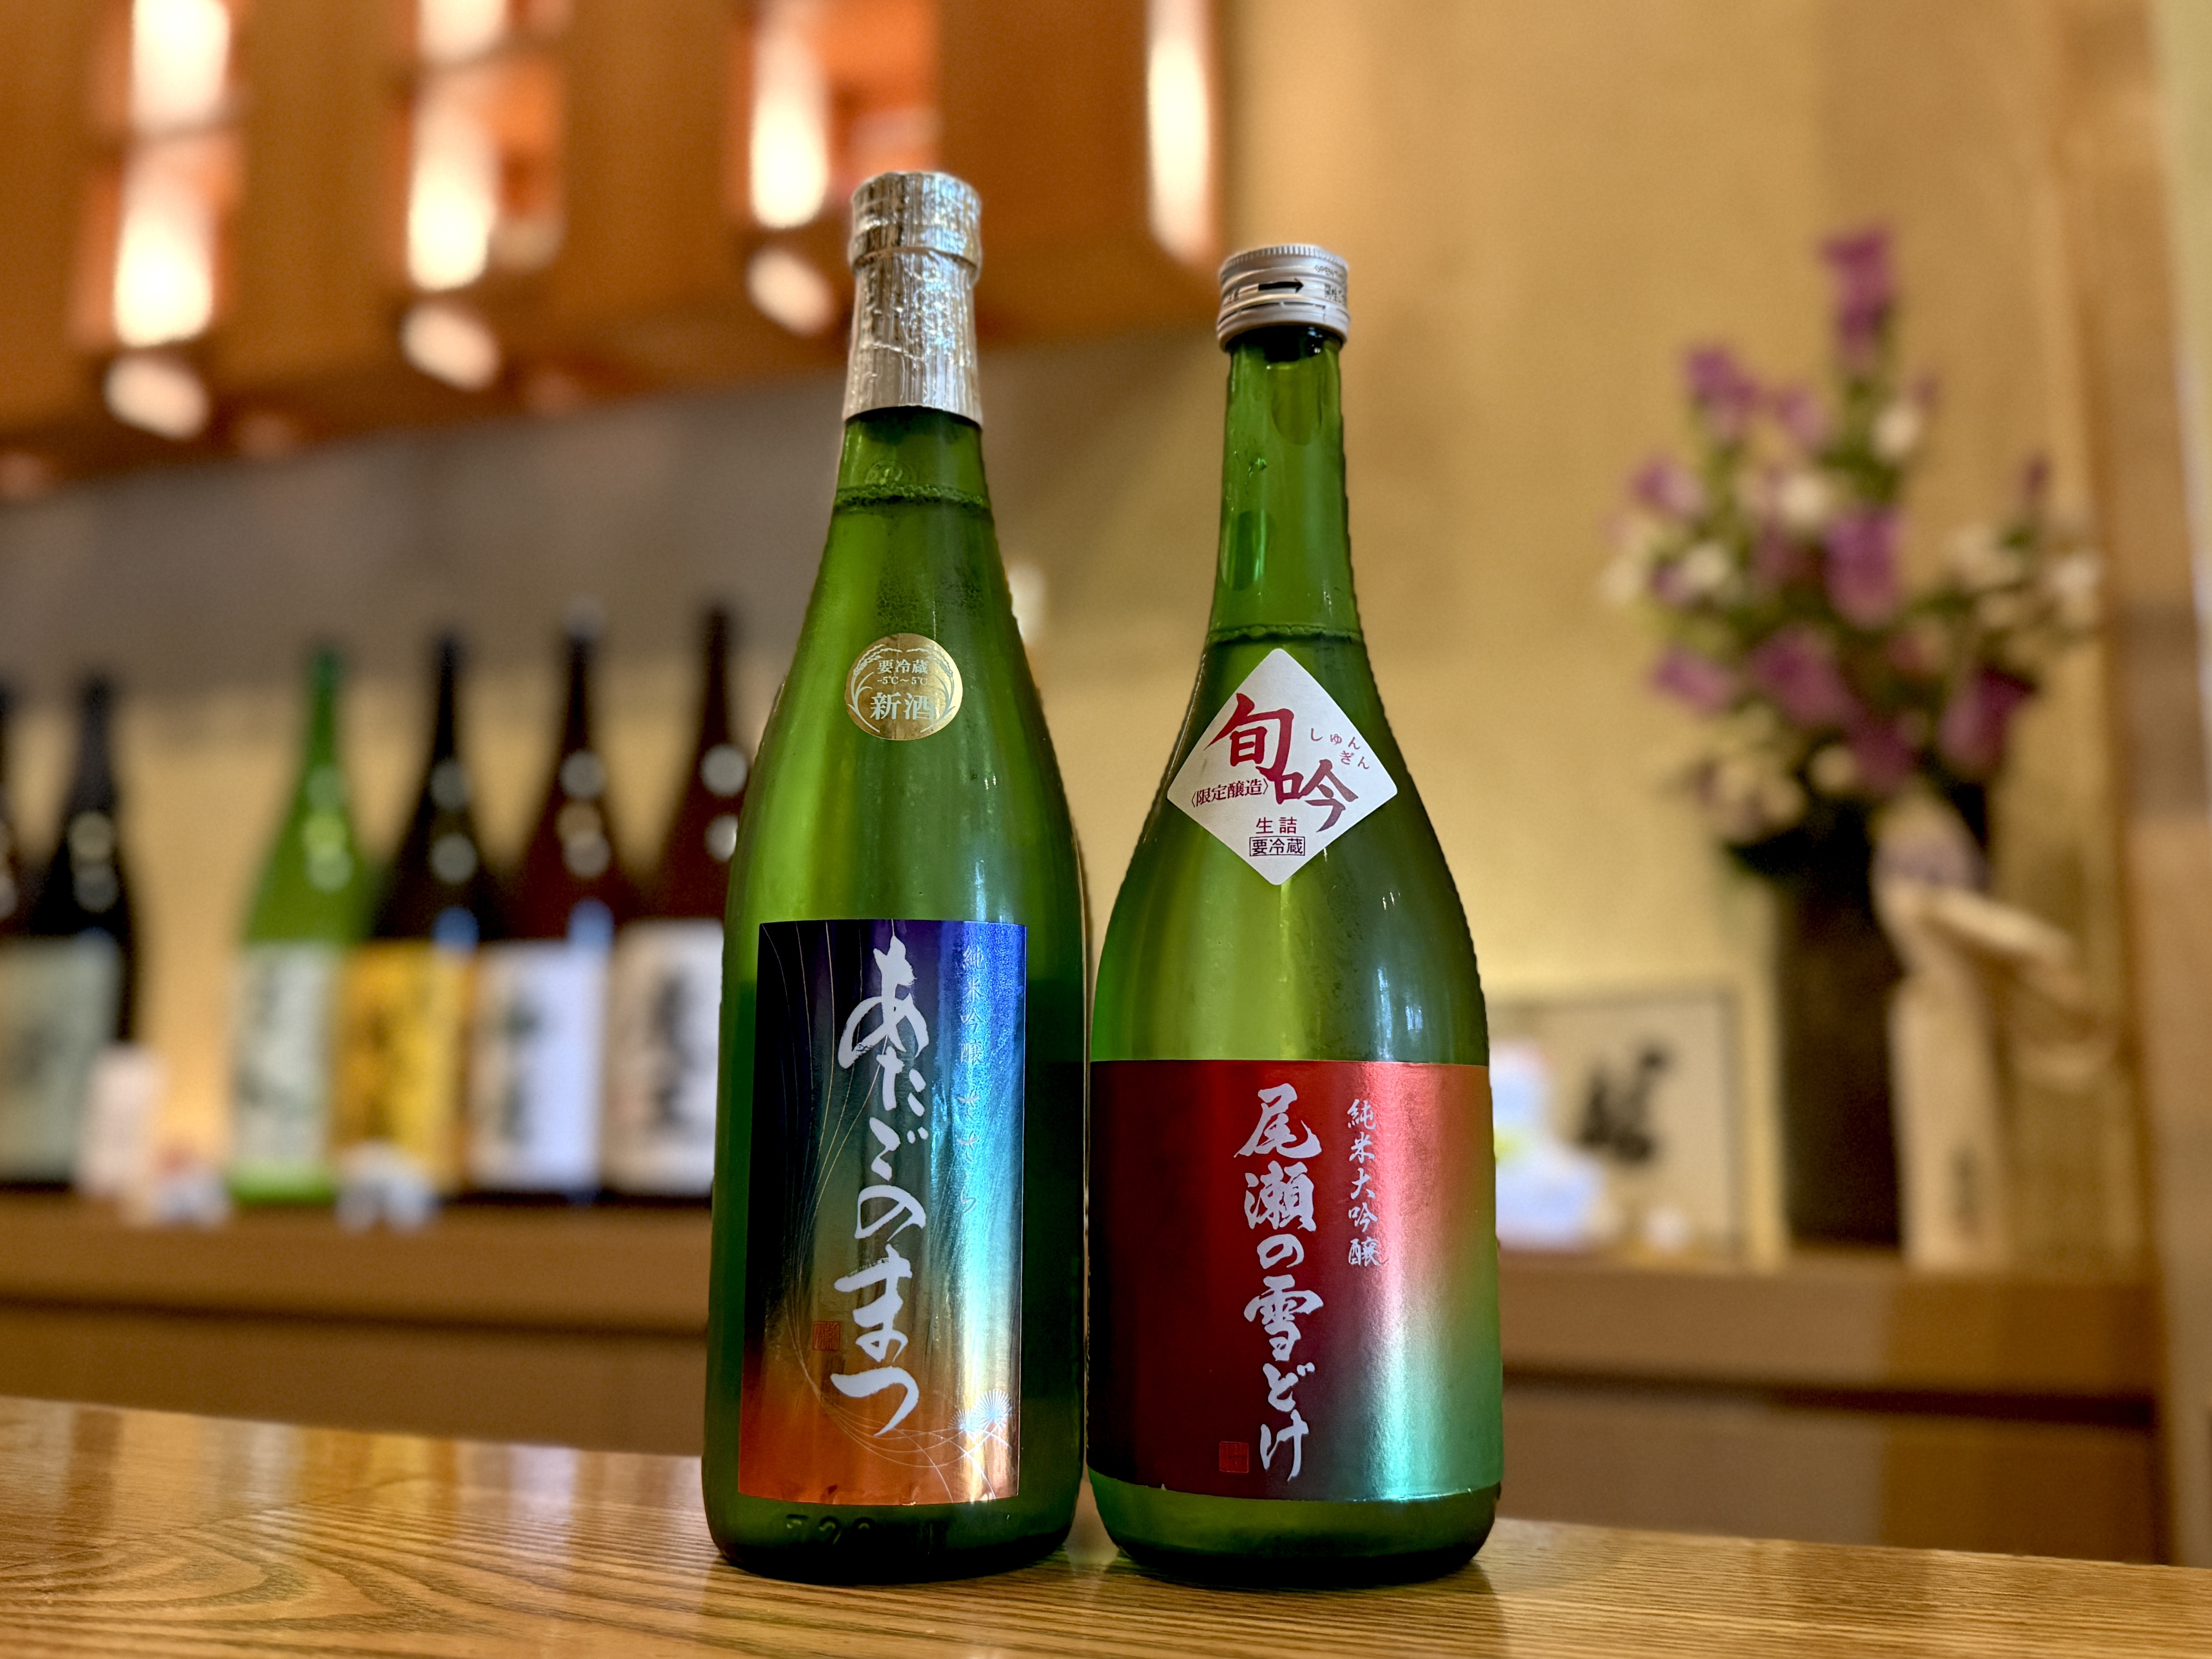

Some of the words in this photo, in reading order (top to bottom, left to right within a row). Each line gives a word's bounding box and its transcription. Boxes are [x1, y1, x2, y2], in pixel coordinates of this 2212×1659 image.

[877, 659, 928, 674] 要冷蔵
[870, 692, 936, 720] 新酒
[1310, 728, 1361, 750] しゅん
[1204, 693, 1359, 833] 旬吟
[1340, 750, 1370, 770] ぎん
[1255, 817, 1298, 834] 生詰
[1252, 838, 1303, 855] 要冷蔵
[1347, 1098, 1381, 1267] 純米大吟醸
[1233, 1083, 1324, 1481] 尾瀬の雪どけ
